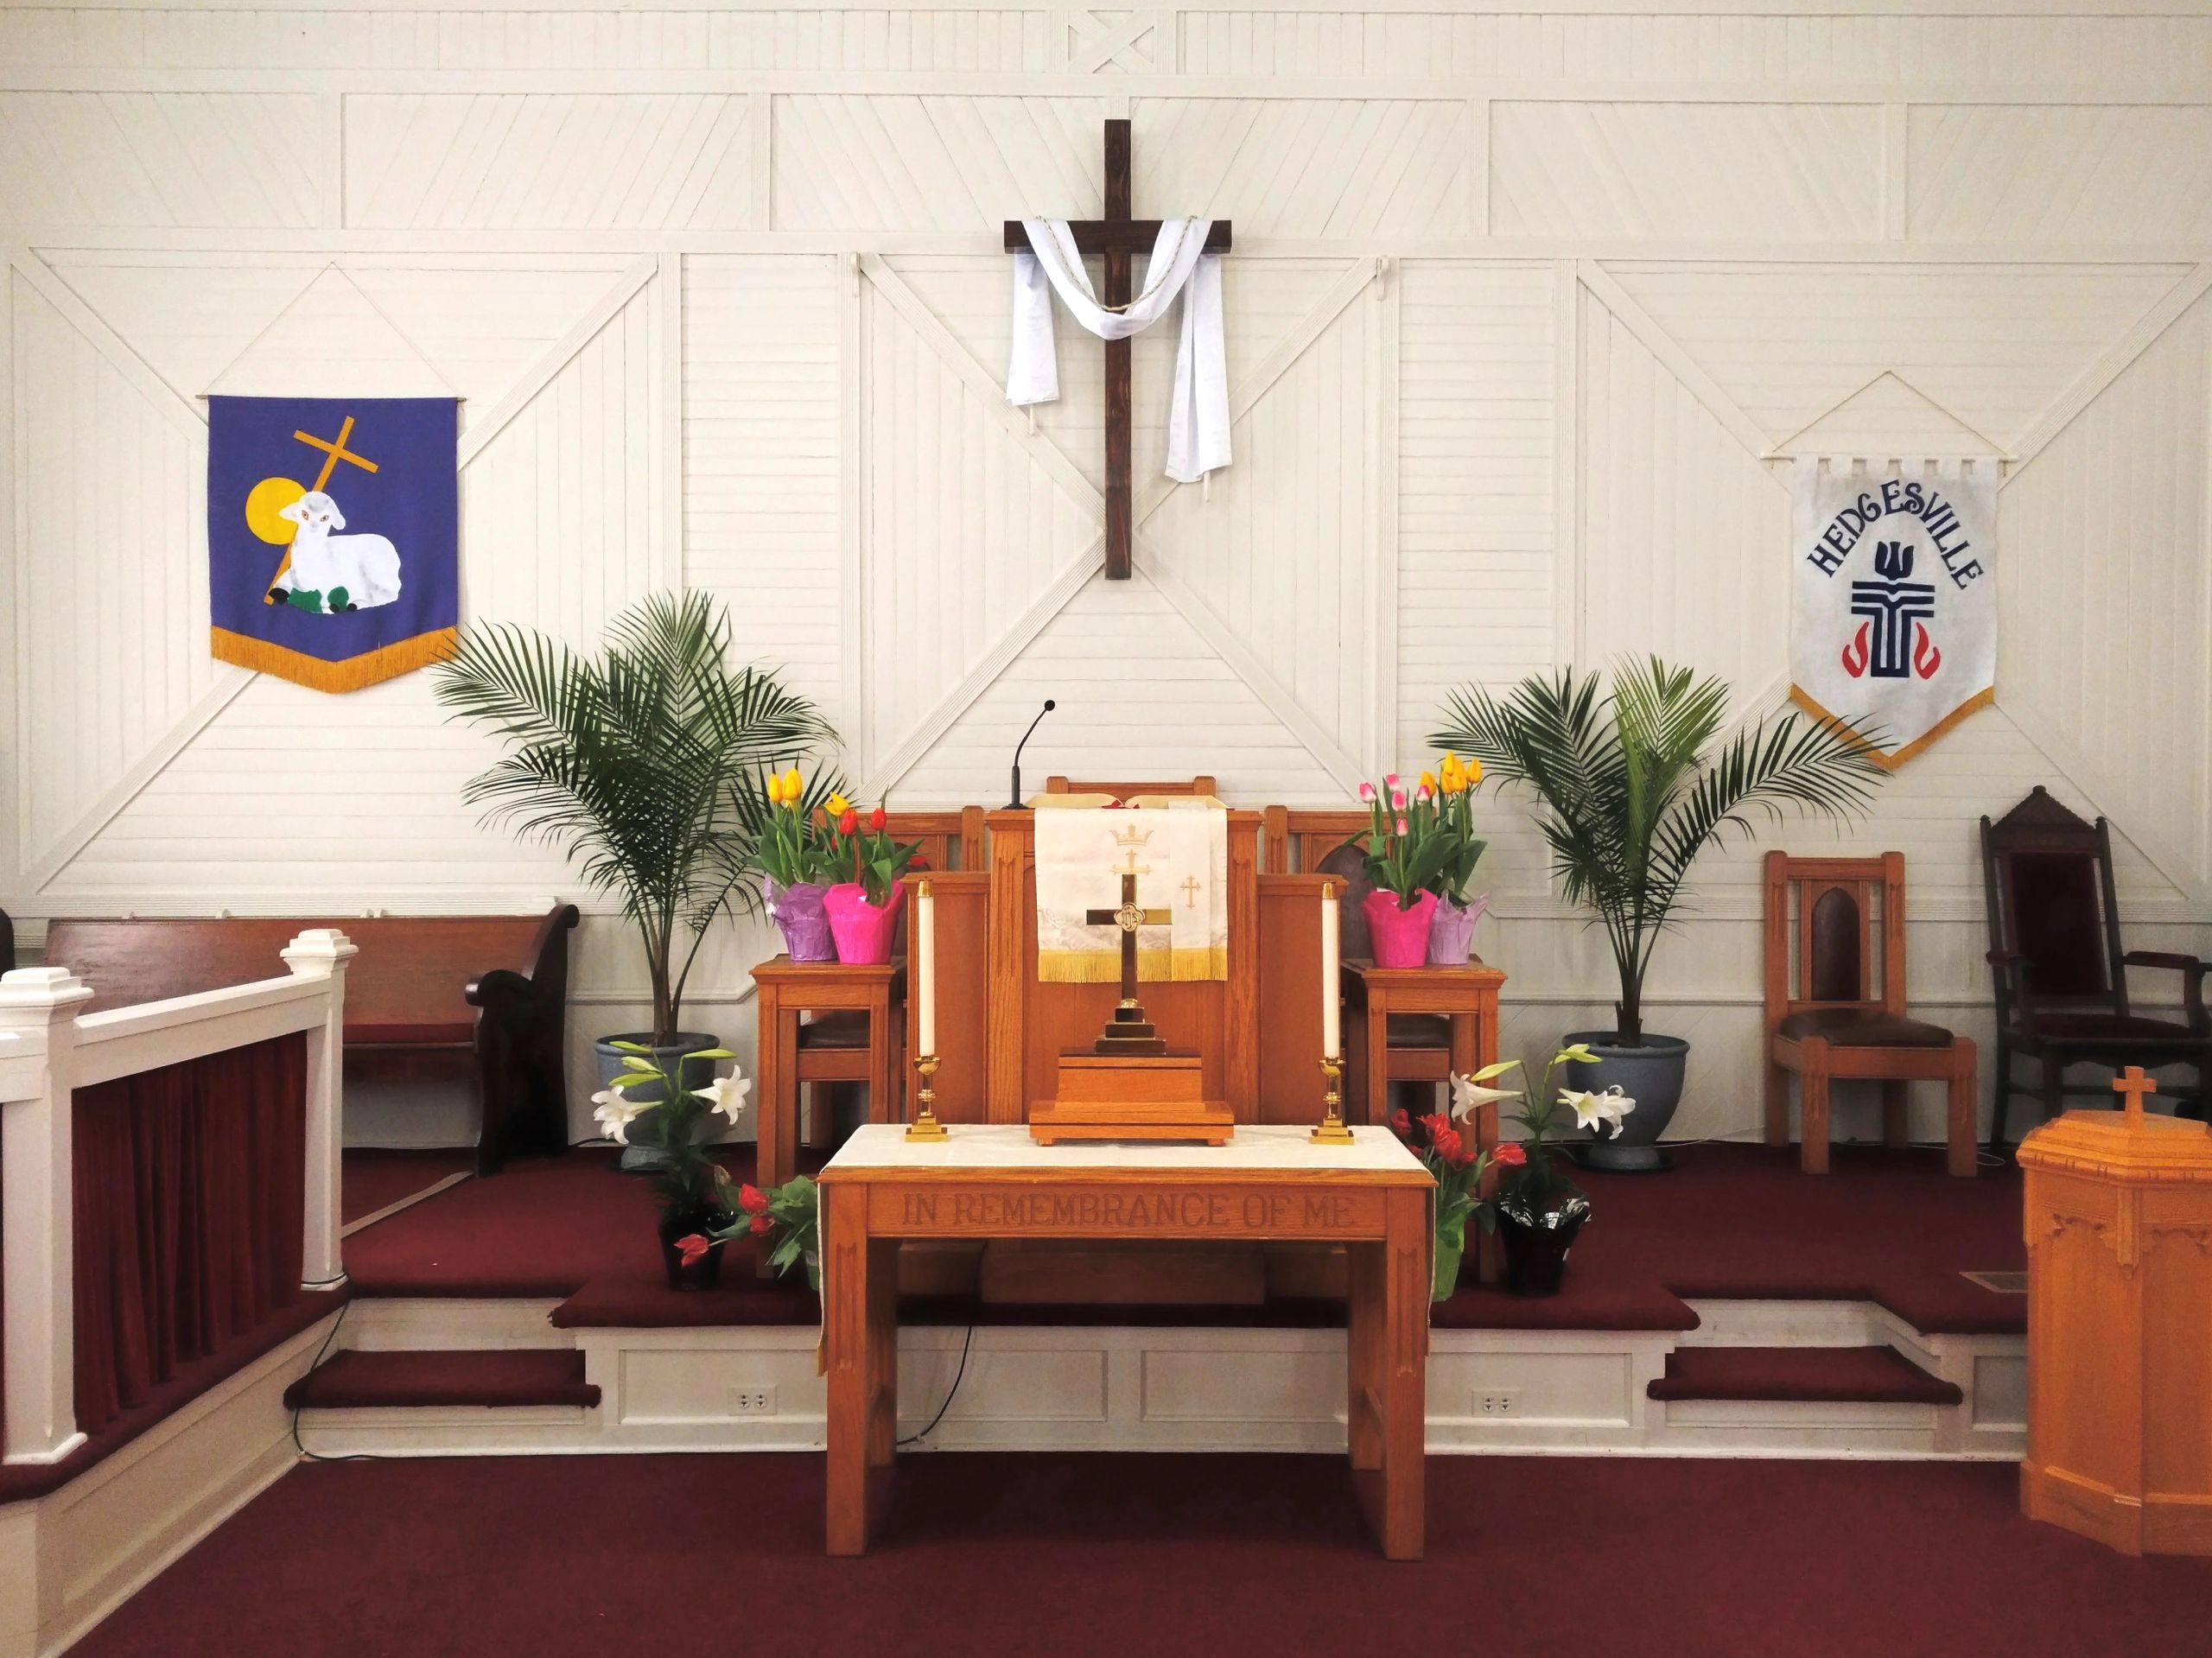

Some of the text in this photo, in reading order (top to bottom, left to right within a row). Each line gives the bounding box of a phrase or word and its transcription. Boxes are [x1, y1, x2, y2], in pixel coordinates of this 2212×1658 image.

[1807, 479, 1984, 590] HEDGESVILLE
[901, 1192, 1356, 1229] IN REMEMBRANCE OF ME
